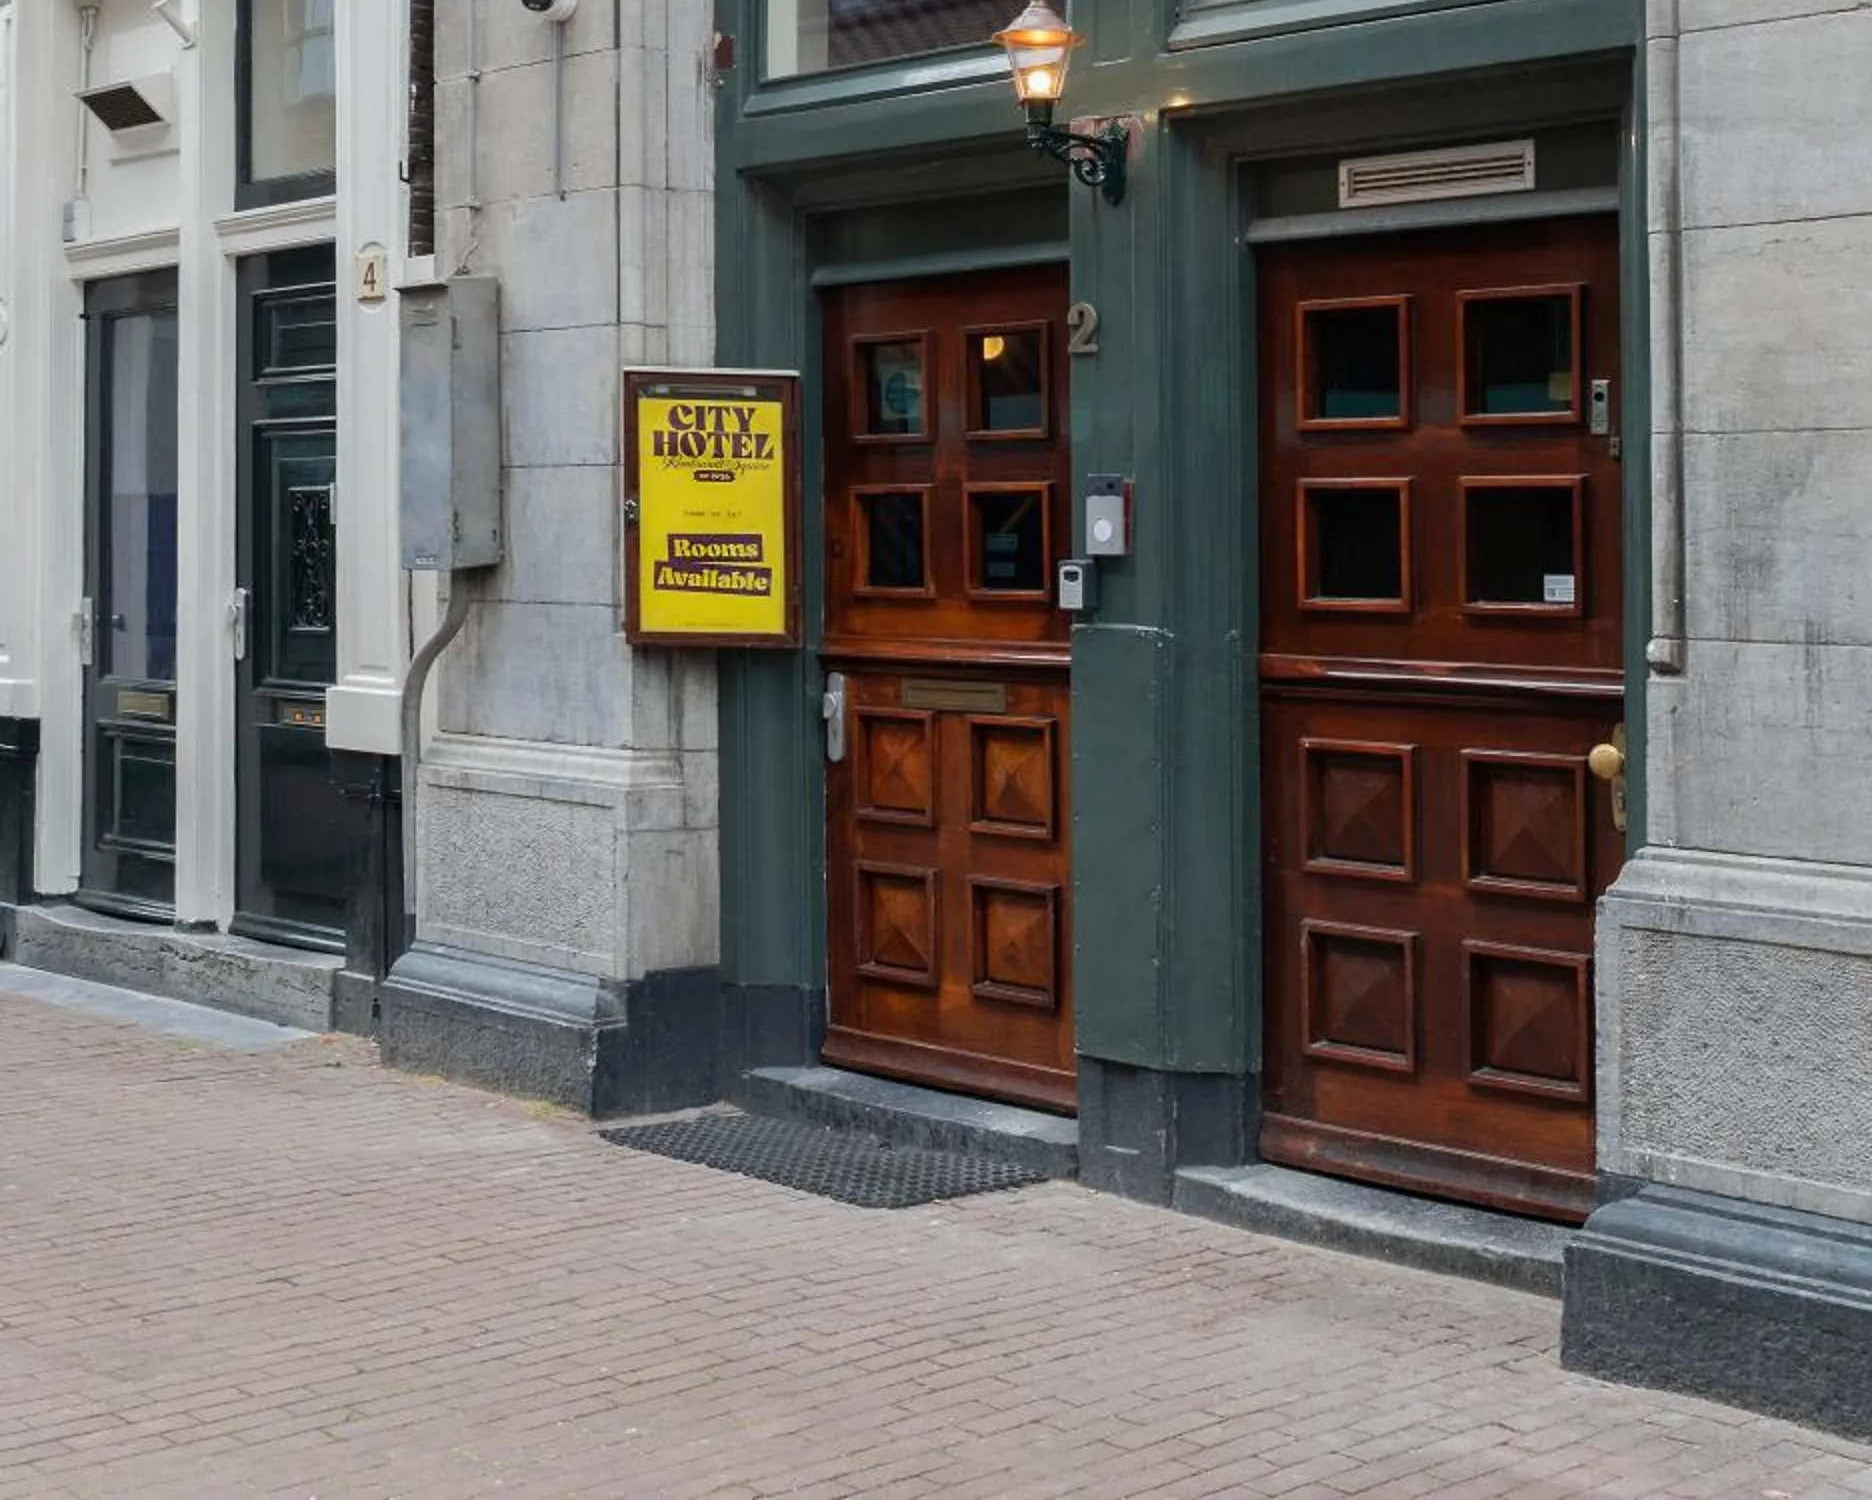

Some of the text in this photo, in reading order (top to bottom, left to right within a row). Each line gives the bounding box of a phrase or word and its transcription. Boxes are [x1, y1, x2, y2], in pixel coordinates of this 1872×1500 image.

[362, 261, 377, 293] 4
[1066, 301, 1099, 354] 2
[668, 404, 756, 433] CITY
[653, 430, 774, 459] HOTEL
[672, 538, 759, 558] Rooms
[657, 567, 768, 592] Available
